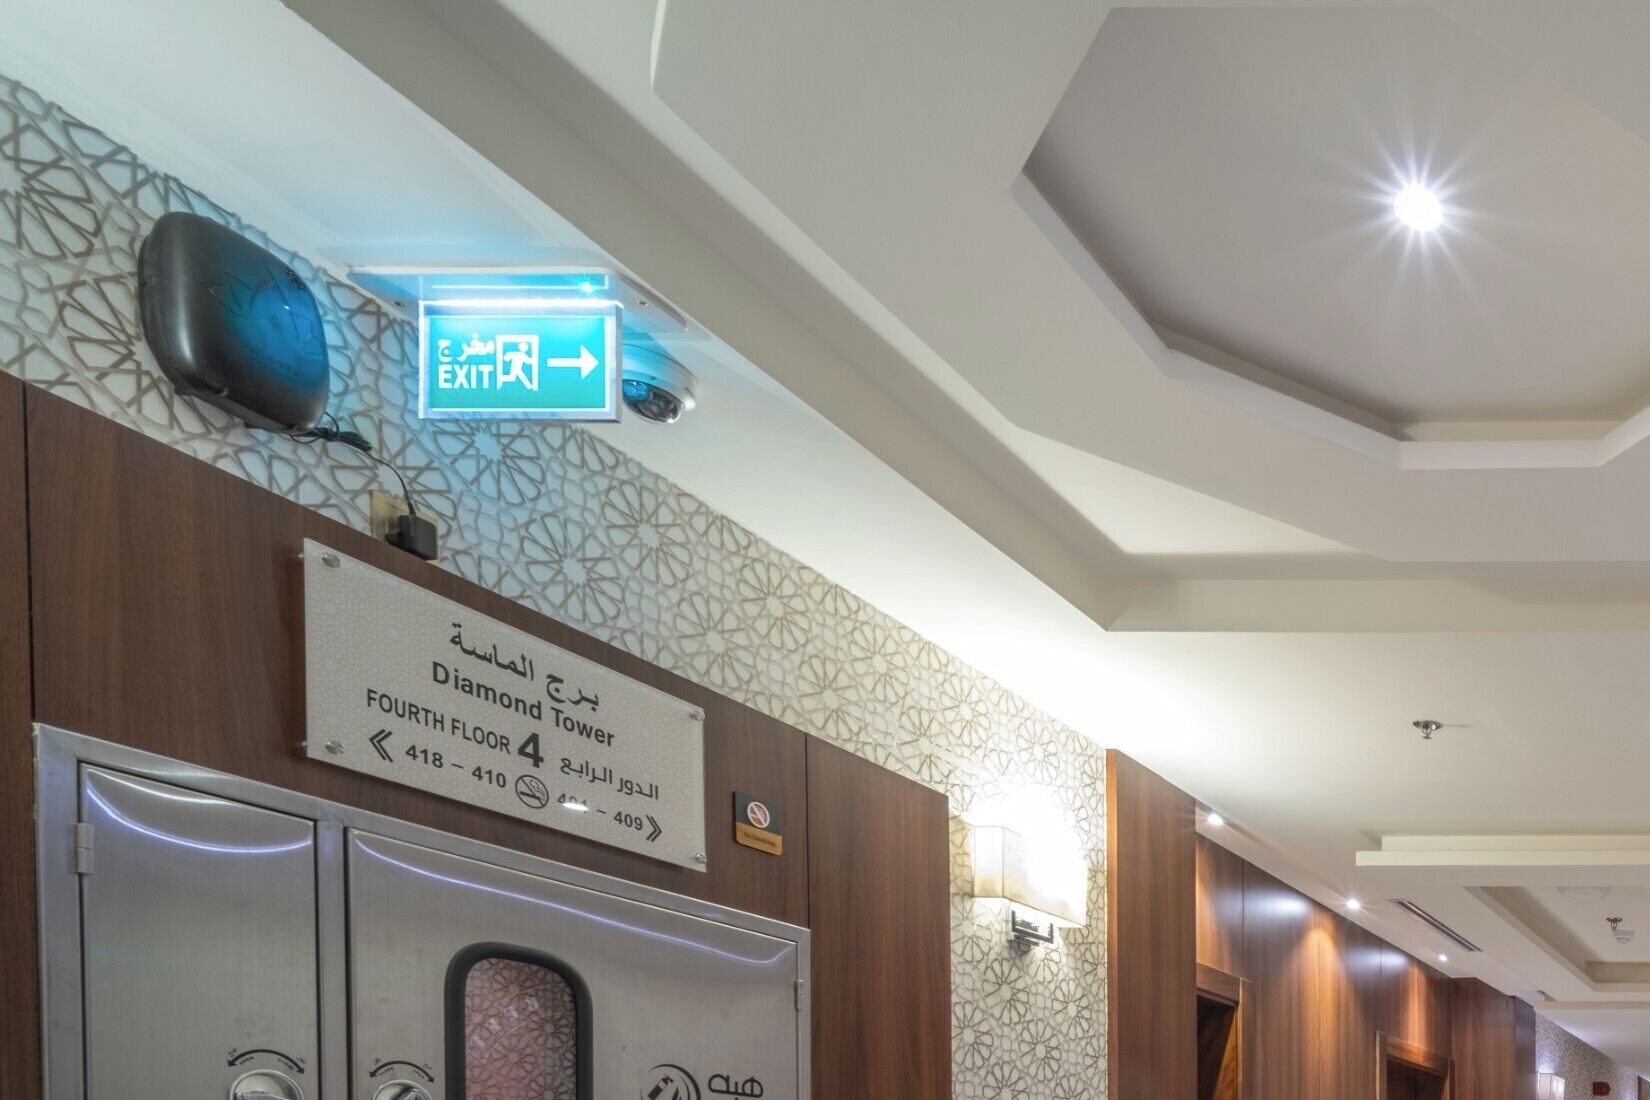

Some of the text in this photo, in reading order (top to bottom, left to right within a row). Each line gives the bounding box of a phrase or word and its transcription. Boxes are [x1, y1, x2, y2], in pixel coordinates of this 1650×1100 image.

[438, 364, 494, 389] EXIT
[450, 622, 599, 712] برج الماسة
[432, 661, 615, 747] Diamond Tower
[367, 688, 544, 768] FOURTH FLOOR 4
[405, 744, 443, 768] 418
[472, 766, 506, 788] 410
[560, 757, 658, 800] الدور الرابع
[614, 811, 643, 831] 409
